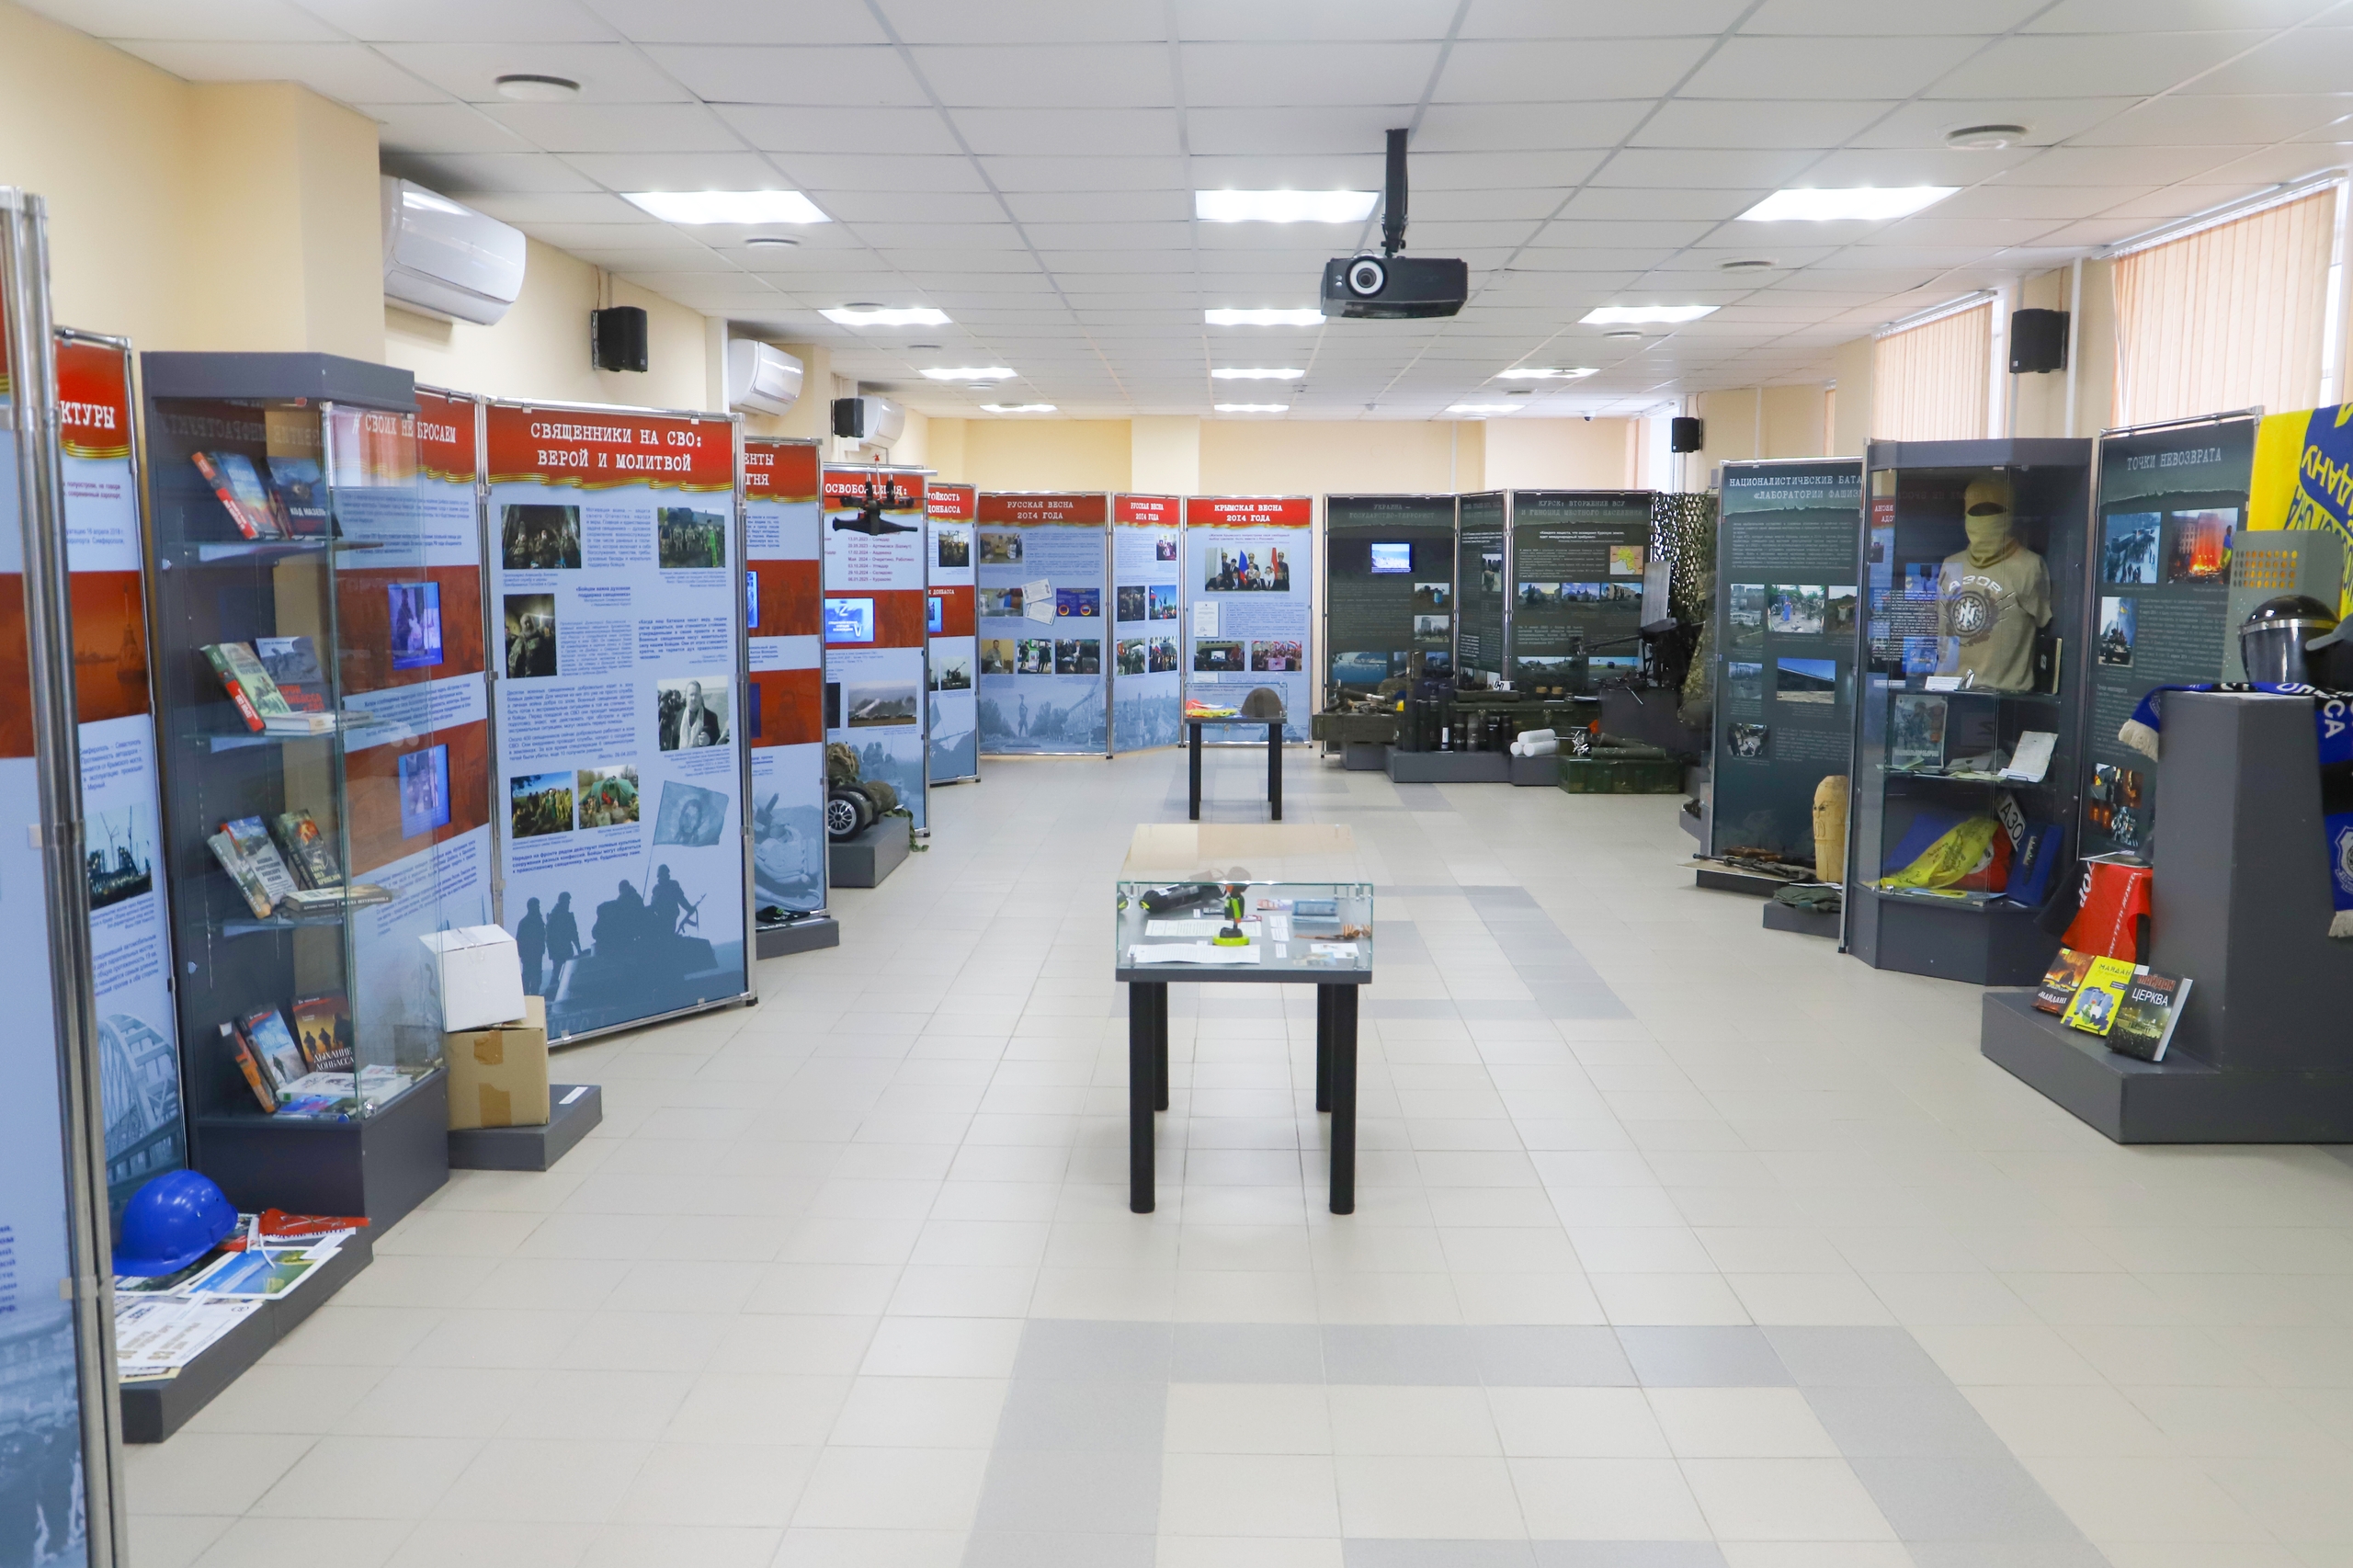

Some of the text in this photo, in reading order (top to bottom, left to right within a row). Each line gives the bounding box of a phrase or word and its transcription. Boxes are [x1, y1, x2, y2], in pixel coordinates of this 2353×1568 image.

[365, 414, 397, 435] СВОИХ
[402, 421, 413, 437] НЕ
[417, 421, 456, 443] БРОСАЕМ
[530, 422, 702, 449] СВЯЩЕННИКИ НА СВО:
[538, 448, 691, 472] ВЕРОЙ И МОЛИТВОЙ
[2127, 447, 2222, 471] ТОЧКИ НЕВОЗВРАТА
[1729, 476, 1833, 487] НАЦИОНАЛИСТИЧЕСКИЕ
[1754, 491, 1824, 499] «ЛАБОРАТОРИИ
[290, 507, 303, 517] КОД
[1949, 575, 2003, 595] АЗОВ
[2099, 964, 2131, 976] МАЙДАН
[2137, 974, 2176, 991] МАЙДАН
[2038, 990, 2068, 1004] МАЙДАНІ
[2132, 988, 2169, 1007] ЦЕРКВА
[314, 1047, 353, 1063] ДЫХАНИЕ
[316, 1056, 354, 1072] ДОНБАССА
